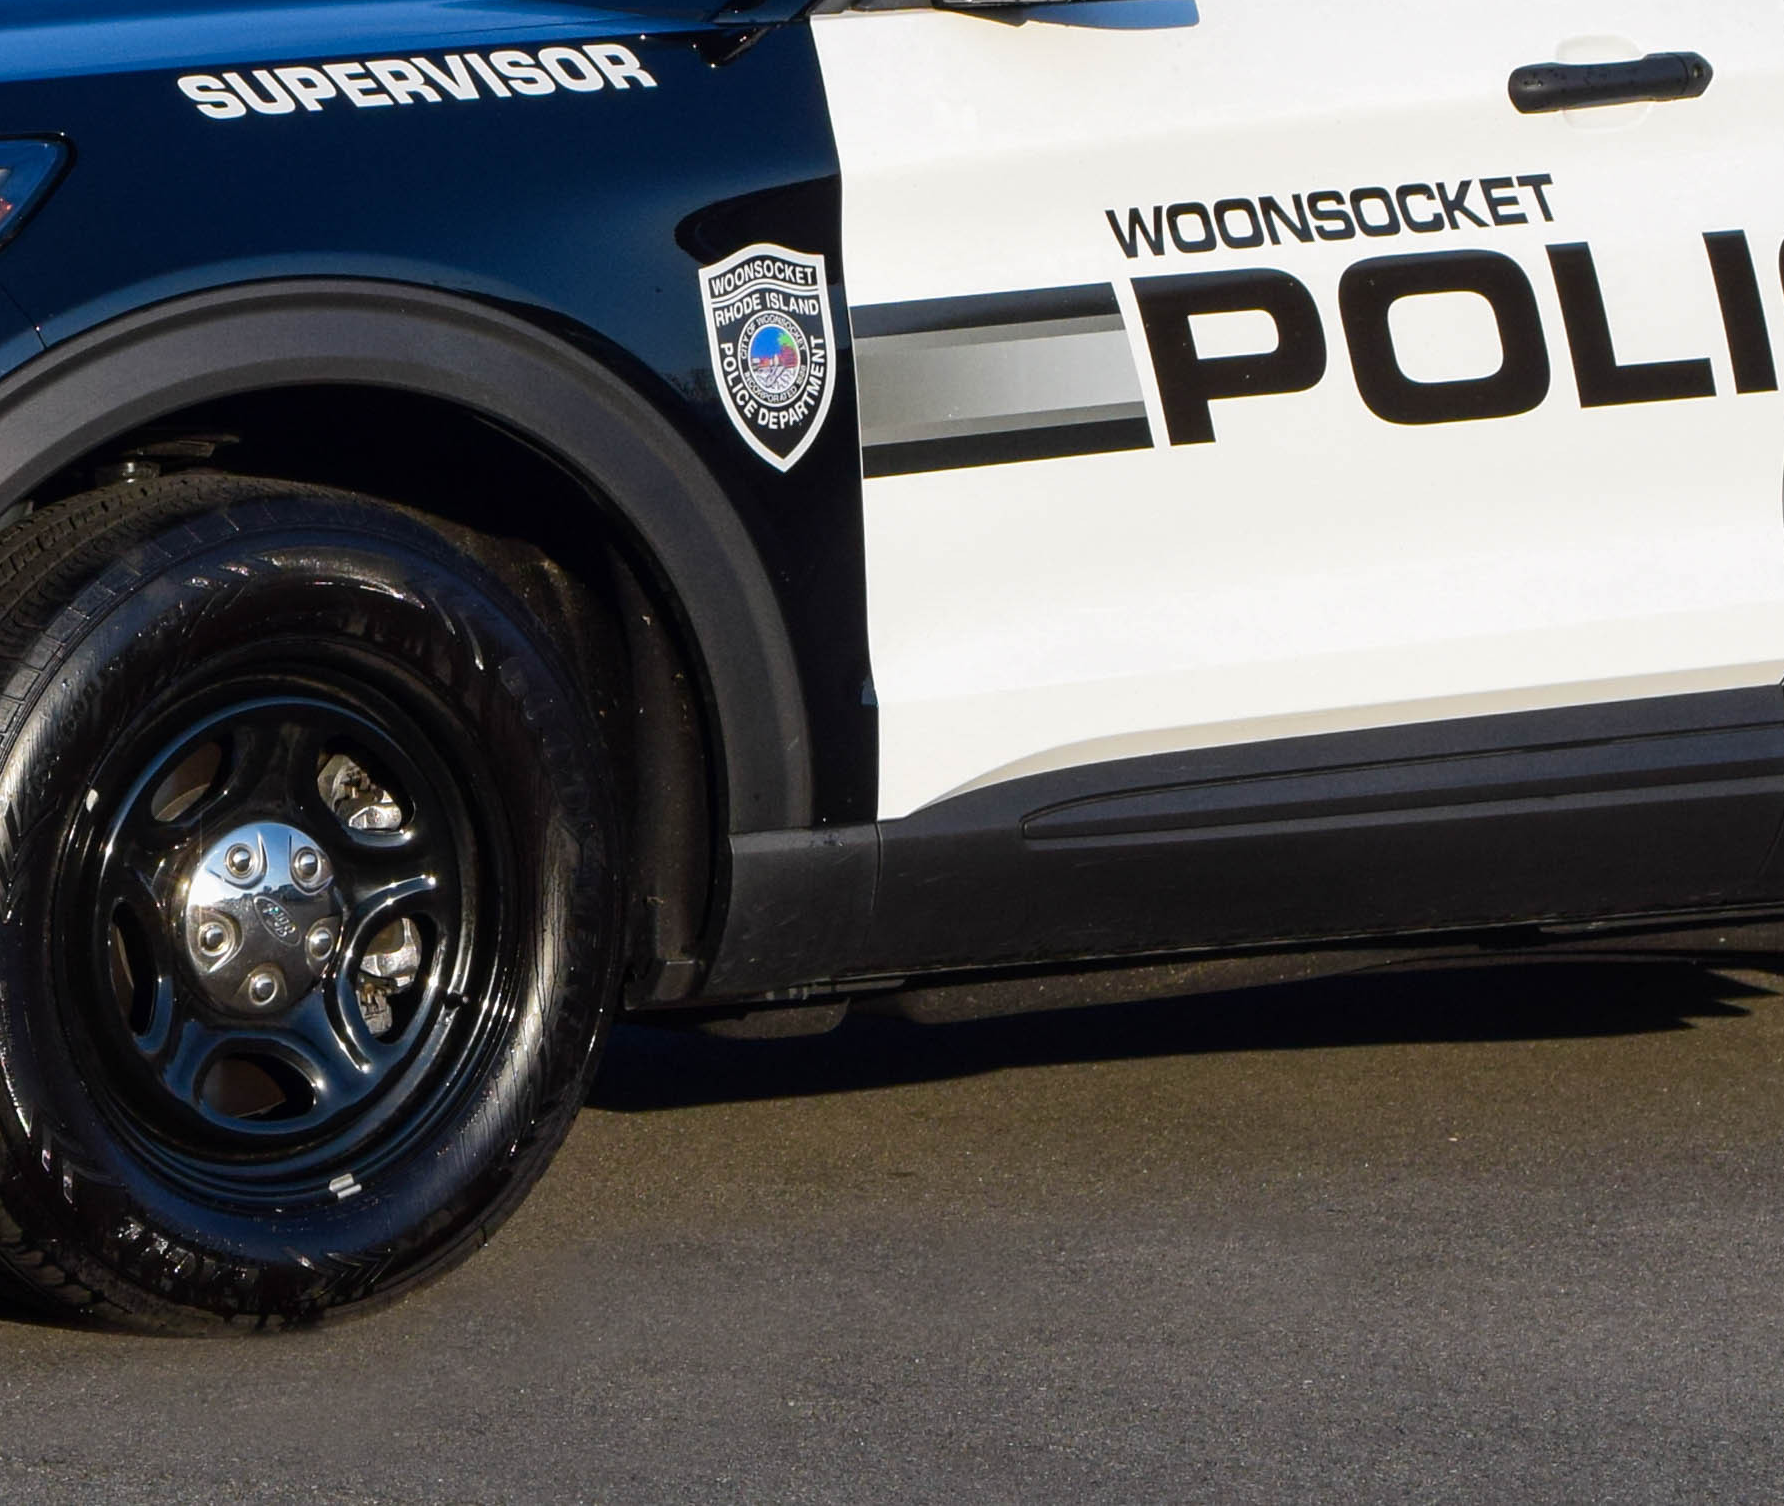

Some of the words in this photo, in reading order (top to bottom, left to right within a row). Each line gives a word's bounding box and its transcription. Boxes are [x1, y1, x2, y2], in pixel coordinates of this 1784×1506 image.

[177, 44, 658, 119] SUPERVISOR
[1105, 173, 1555, 259] WOONSOCKET
[711, 259, 814, 296] WOONSOCKET
[714, 293, 761, 328] RHODE
[765, 292, 819, 316] ISLAND
[740, 335, 750, 360] CITY
[746, 323, 757, 336] OF
[756, 314, 807, 351] WOONSOCKET
[720, 342, 759, 418] POLICE
[756, 336, 826, 430] DEPARTMENT
